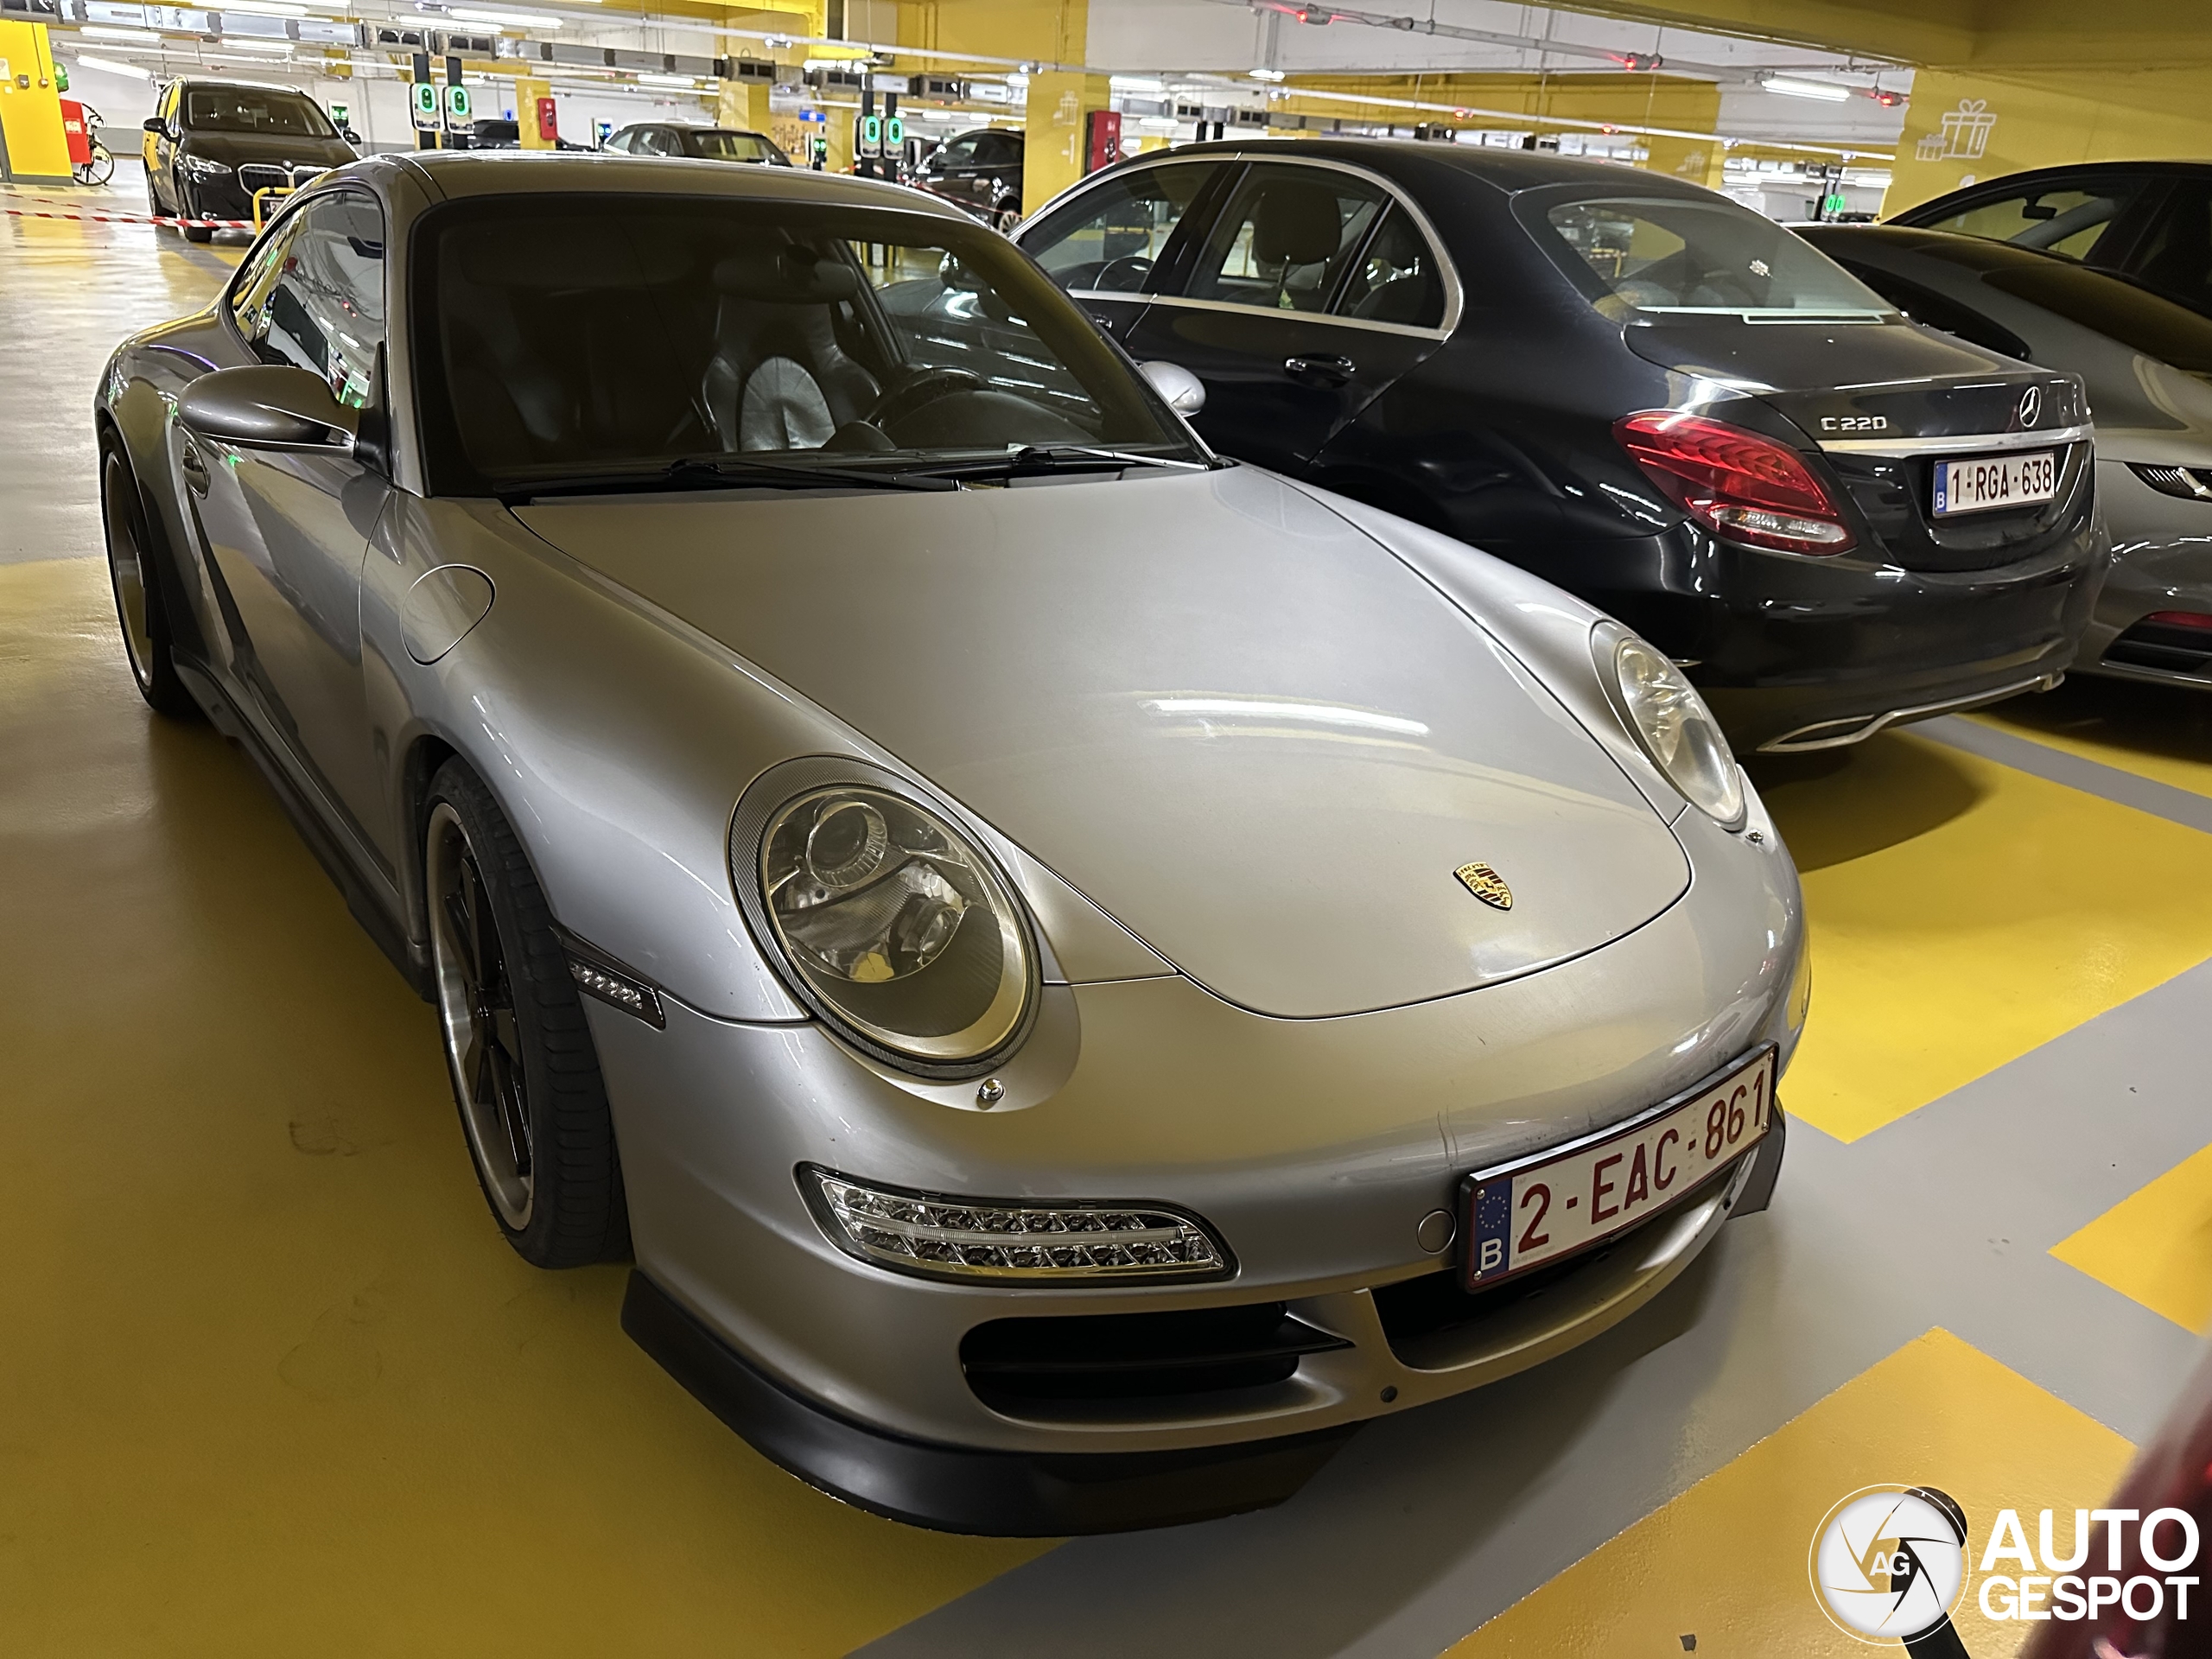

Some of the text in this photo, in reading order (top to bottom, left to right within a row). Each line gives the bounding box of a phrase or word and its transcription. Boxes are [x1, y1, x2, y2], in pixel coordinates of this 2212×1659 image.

[1821, 416, 1887, 431] C 220
[1936, 491, 1945, 510] B
[1517, 1069, 1765, 1255] 2-EAC-861
[1479, 1237, 1503, 1273] B
